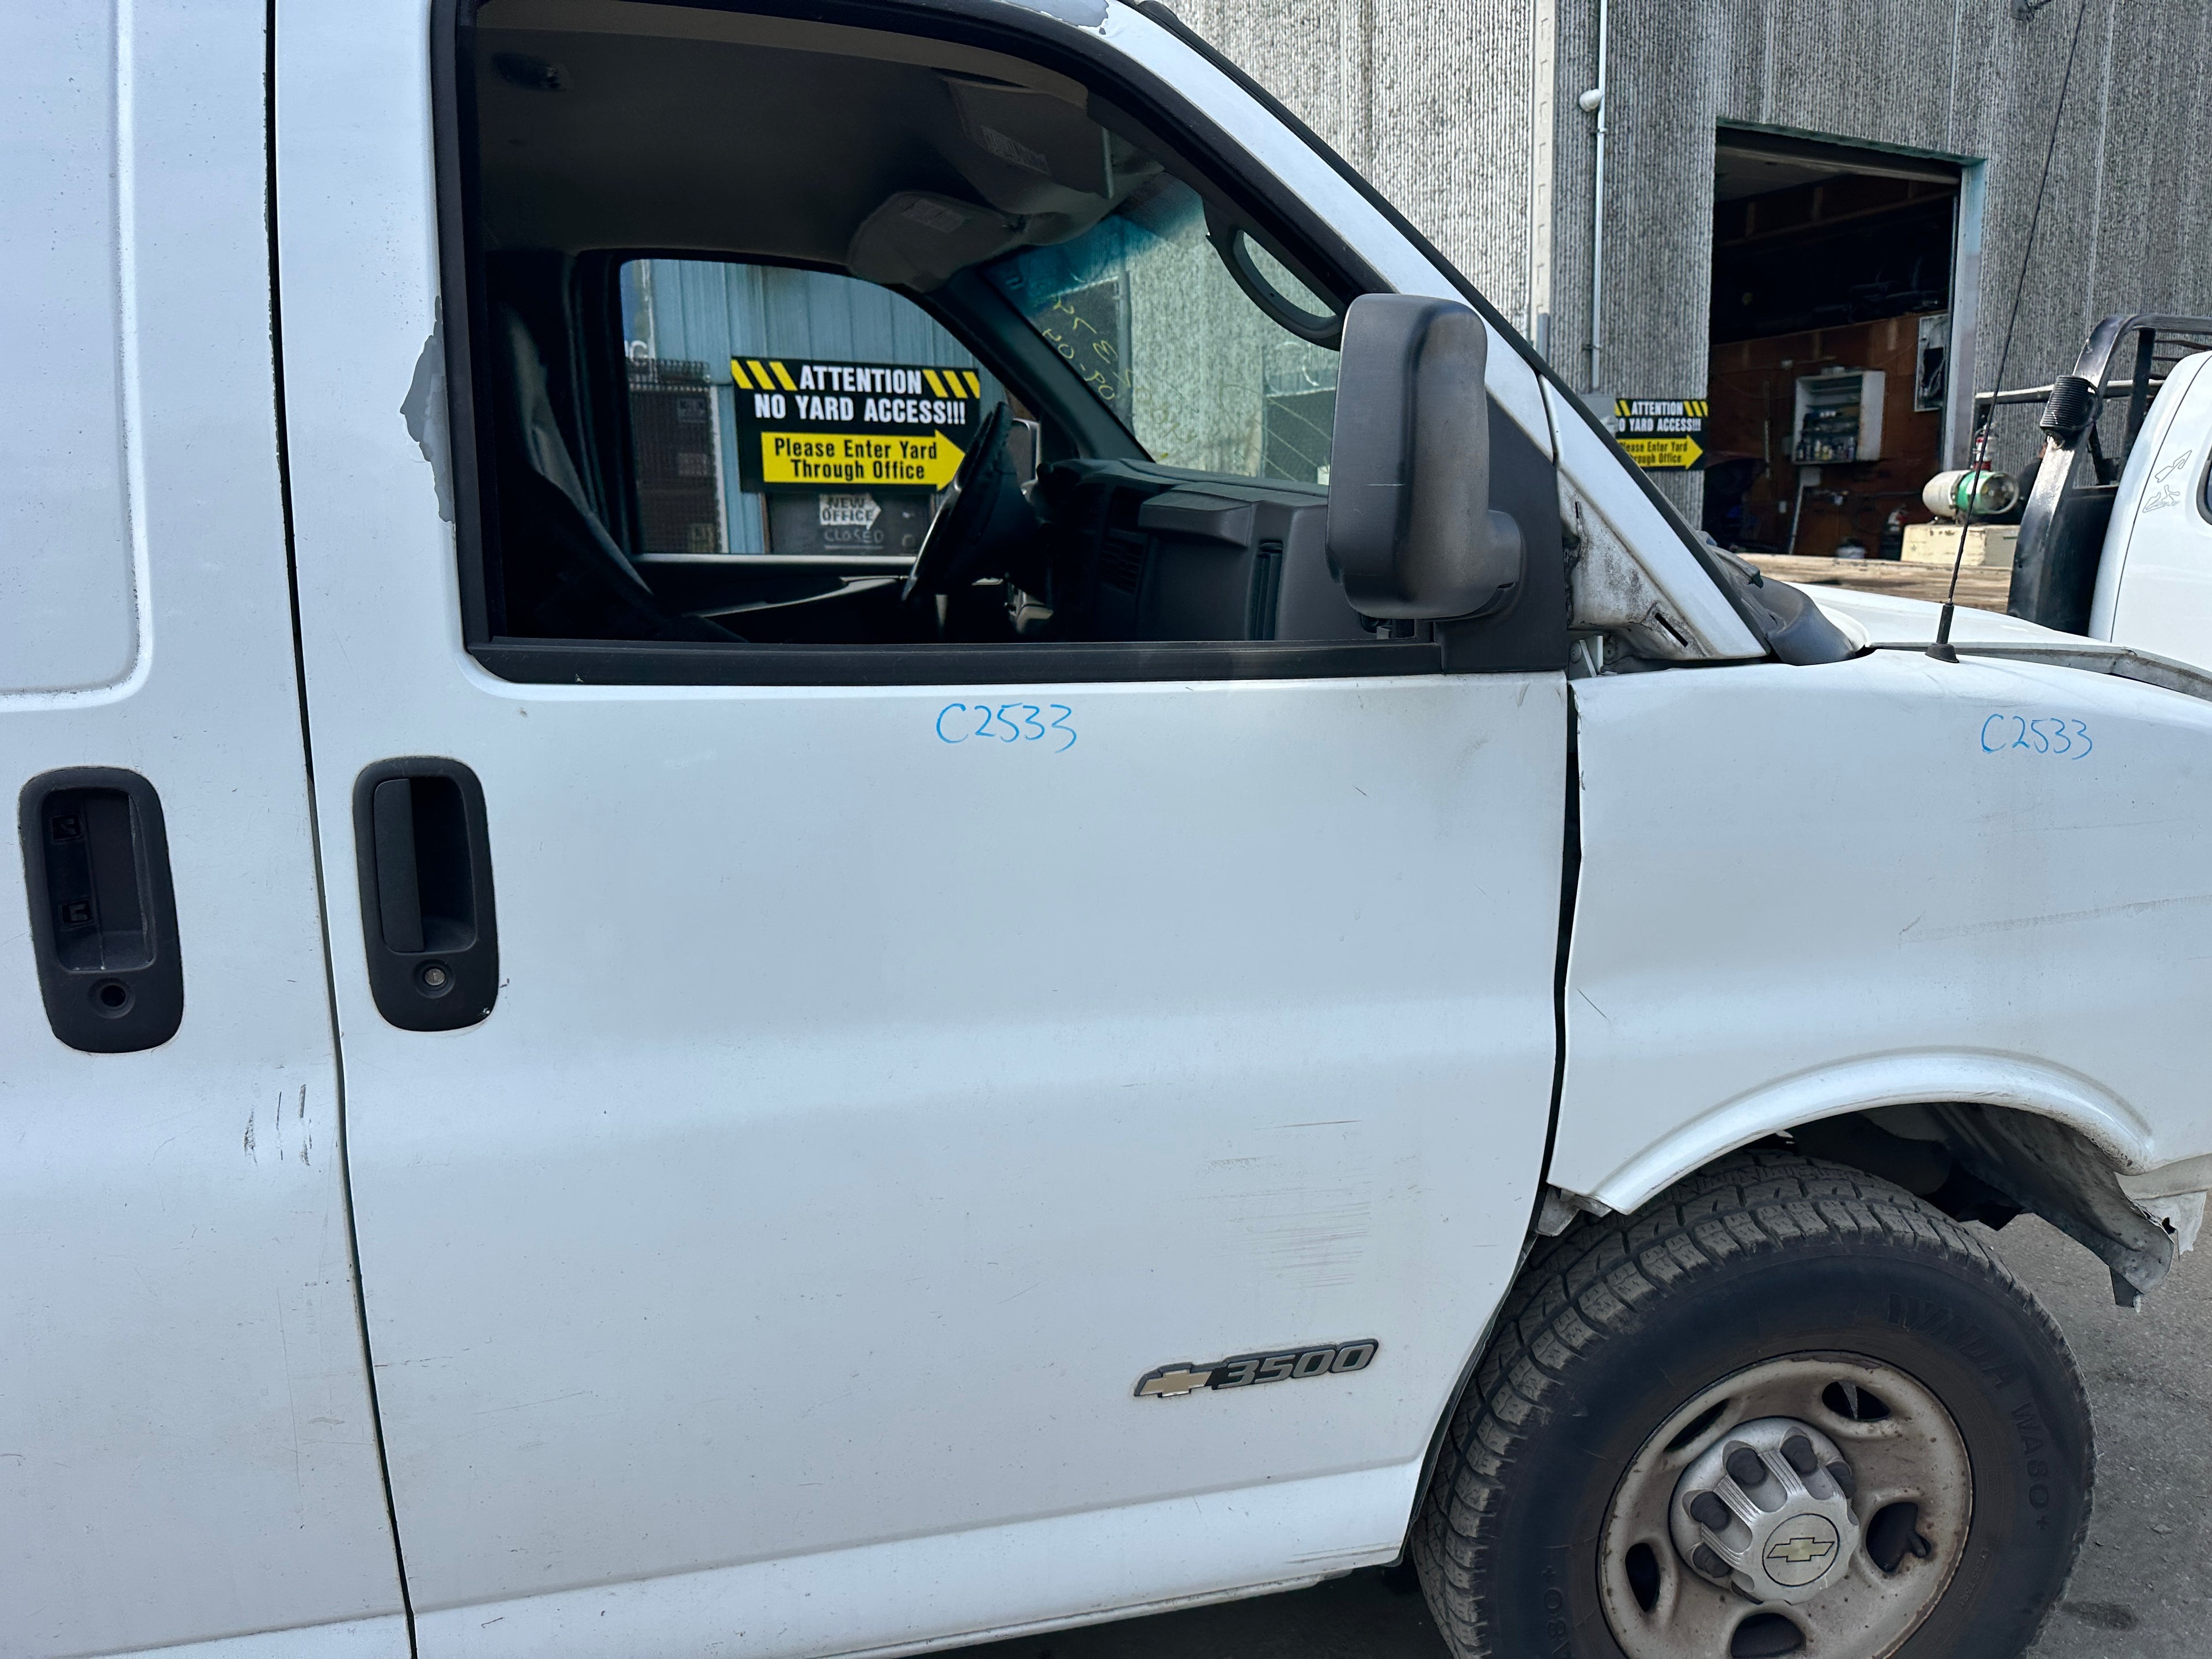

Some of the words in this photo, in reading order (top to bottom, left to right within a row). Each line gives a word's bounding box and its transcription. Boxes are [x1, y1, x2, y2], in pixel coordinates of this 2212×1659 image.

[800, 365, 922, 395] ATTENTION
[754, 393, 786, 419] NO
[795, 395, 854, 421] YARD
[864, 397, 966, 425] ACCESS!!!
[1631, 401, 1684, 416] ATTENTION
[1629, 418, 1654, 432] YARD
[1656, 417, 1702, 432] ACCESS!!!
[774, 437, 835, 457] Please
[844, 439, 892, 459] Enter
[899, 441, 937, 460] Yard
[1647, 441, 1668, 453] Enter
[1671, 441, 1688, 452] Yard
[1658, 453, 1682, 464] Office
[791, 459, 865, 482] Through
[873, 460, 925, 480] Office
[828, 497, 865, 508] NEW
[822, 509, 875, 521] OFFICE
[935, 702, 1077, 753] C2533
[1980, 713, 2093, 761] C2533
[1217, 1343, 1376, 1389] 3500
